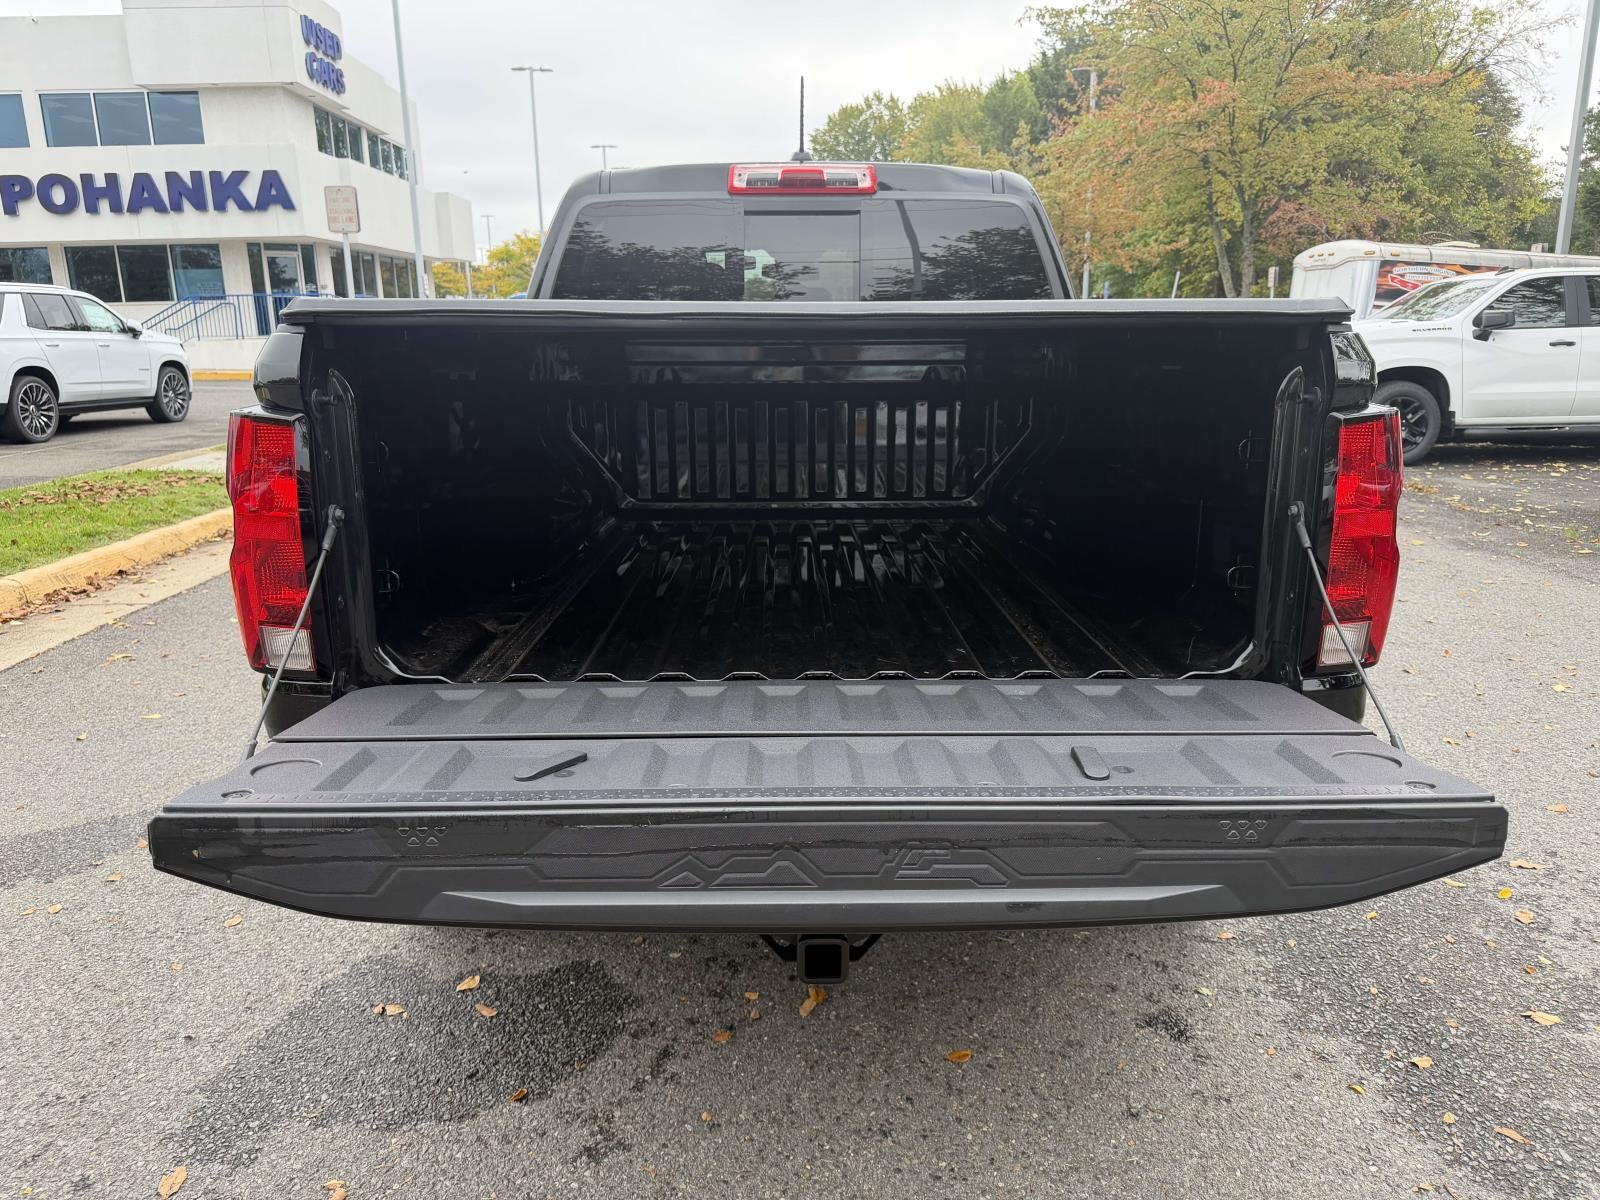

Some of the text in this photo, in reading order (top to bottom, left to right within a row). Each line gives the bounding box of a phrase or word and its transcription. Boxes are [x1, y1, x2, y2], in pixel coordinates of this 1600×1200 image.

[300, 14, 342, 61] USED
[305, 51, 346, 95] CARS
[0, 169, 297, 216] POHANKA
